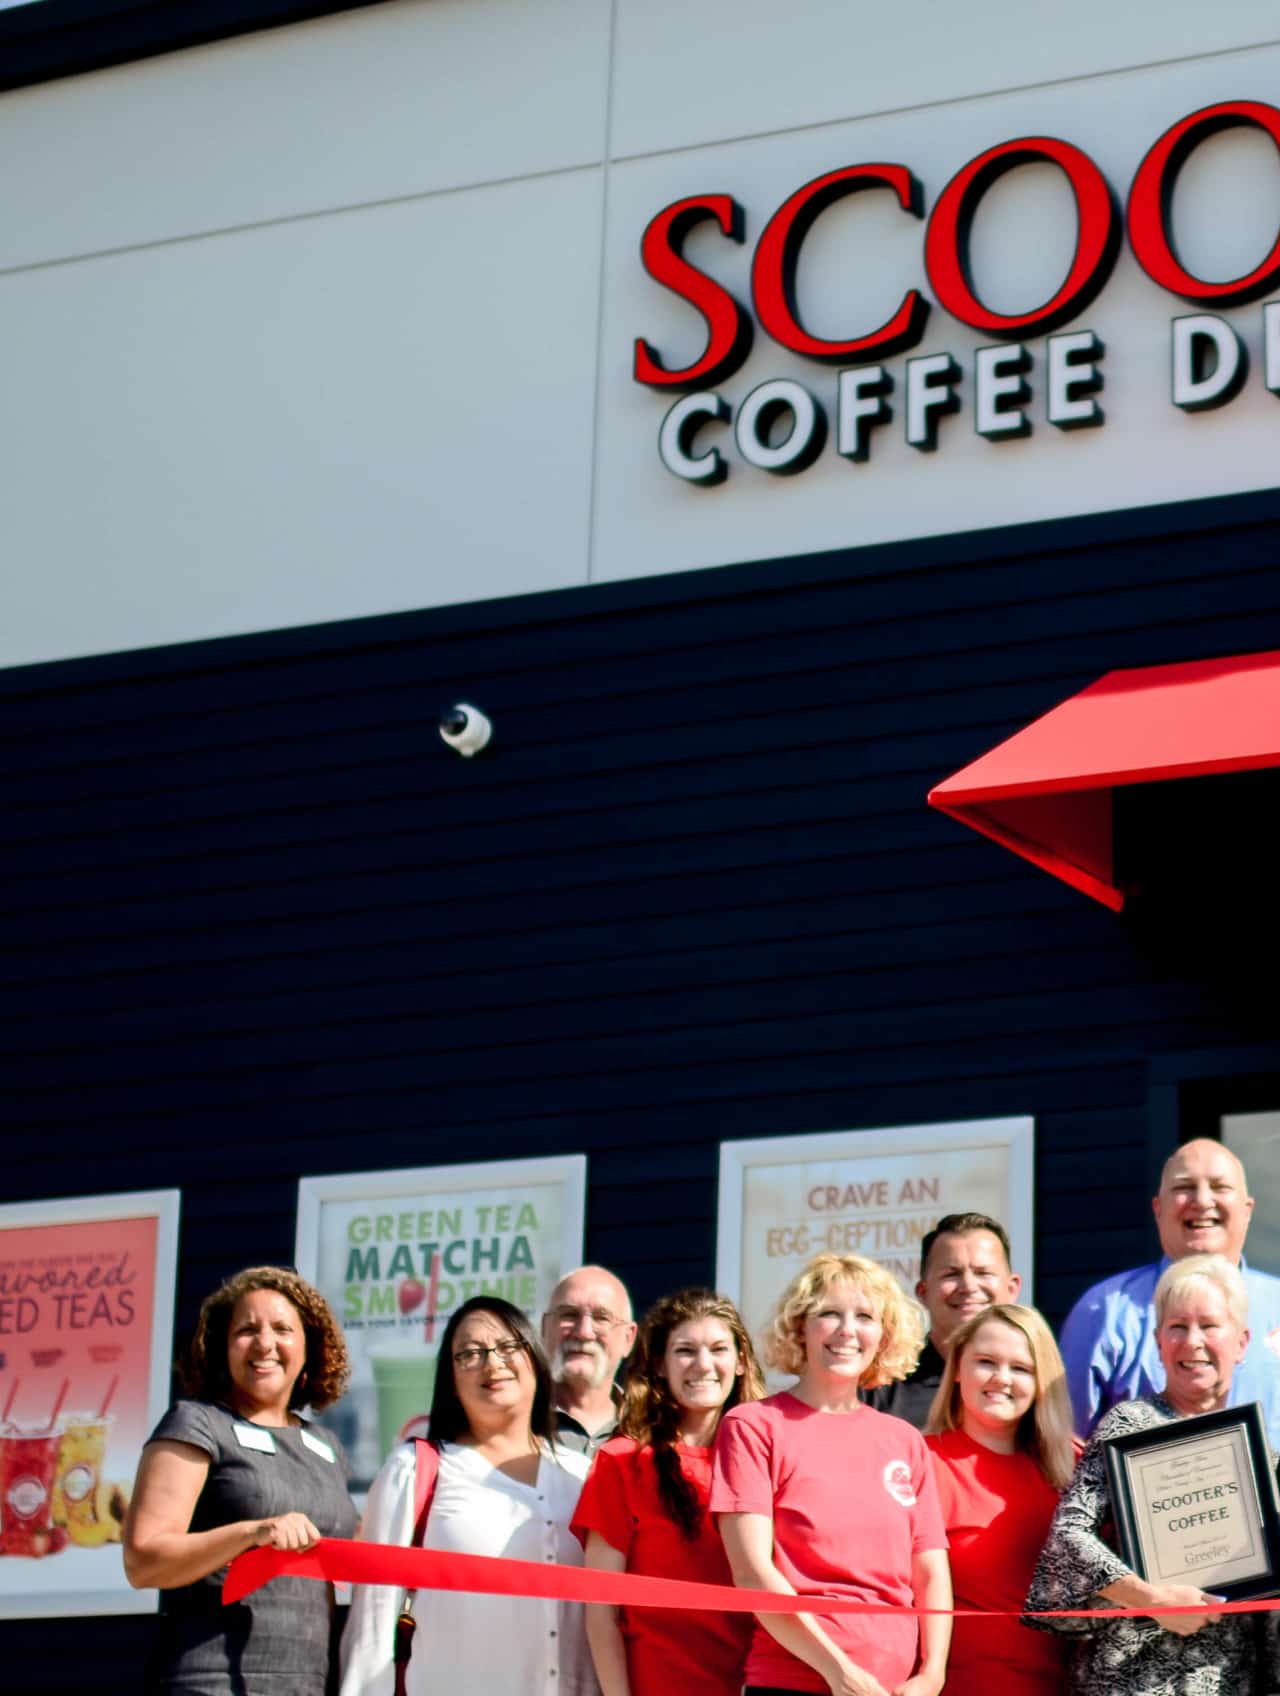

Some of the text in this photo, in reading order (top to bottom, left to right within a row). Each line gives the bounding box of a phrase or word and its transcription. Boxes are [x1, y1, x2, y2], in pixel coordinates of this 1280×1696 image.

[658, 330, 1103, 486] COFFEE
[807, 1178, 940, 1212] CRAVE AN
[347, 1203, 540, 1244] GREEN TEA
[345, 1236, 535, 1283] MATCHA
[53, 1289, 135, 1330] TEAS
[344, 1276, 537, 1318] SMOTHIE
[1151, 1481, 1239, 1514] SCOOTER'S
[1168, 1506, 1231, 1532] COFFEE
